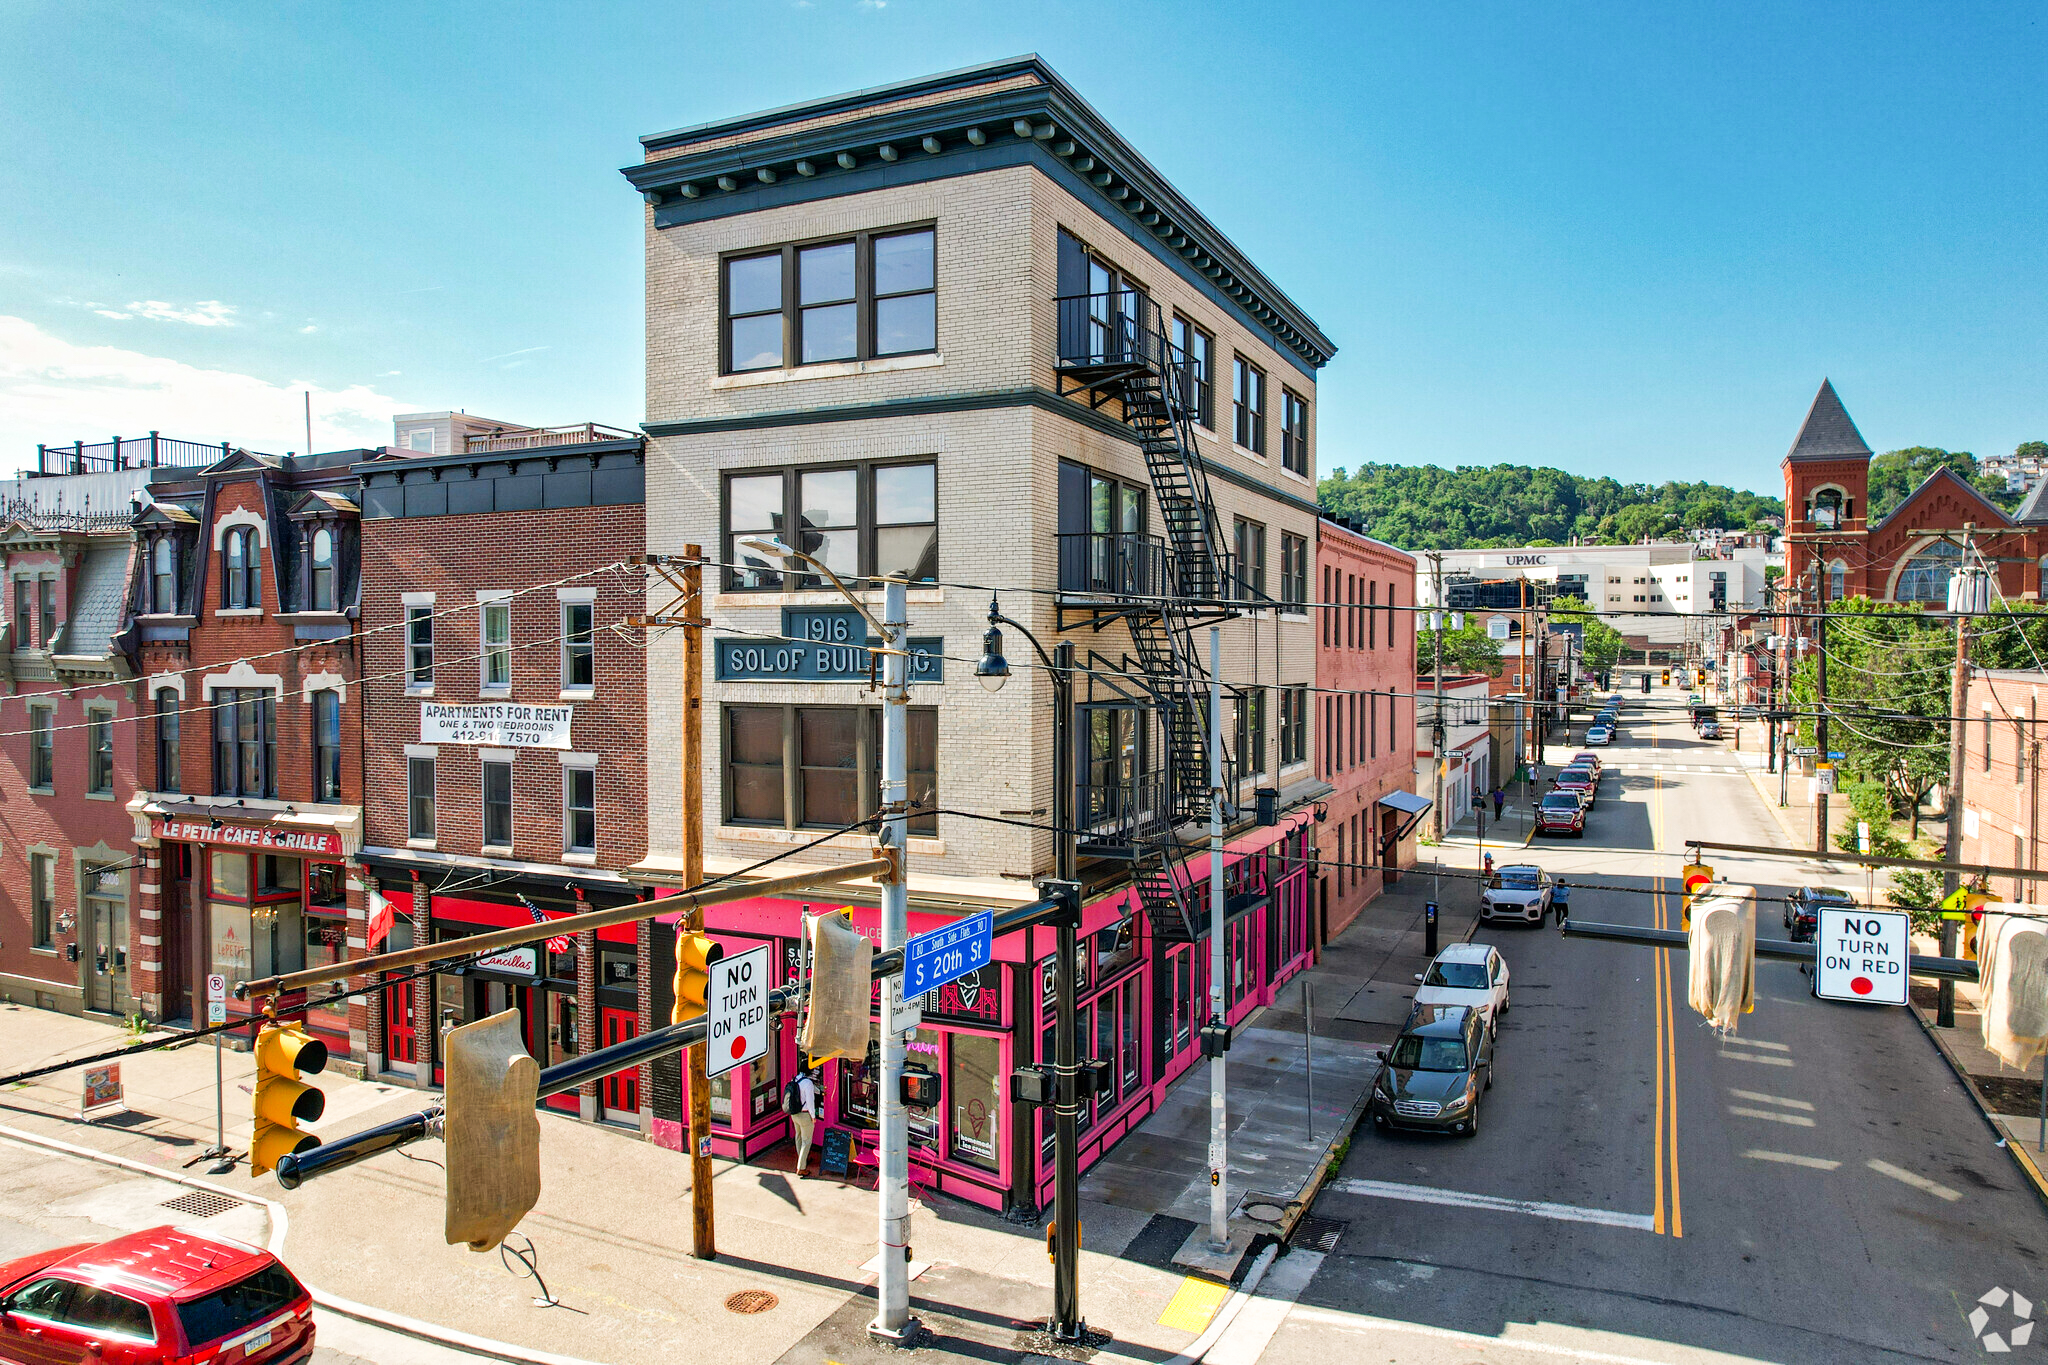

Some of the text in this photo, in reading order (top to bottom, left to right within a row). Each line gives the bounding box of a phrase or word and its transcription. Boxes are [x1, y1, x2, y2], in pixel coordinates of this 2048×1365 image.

[1505, 555, 1546, 565] UPMC
[731, 648, 806, 671] SOLOF
[426, 705, 569, 721] APARTMENTS FOR RENT
[439, 720, 459, 728] ONE
[472, 721, 494, 729] TWO
[496, 721, 554, 731] BEDROOMS
[1820, 777, 1830, 785] 15
[162, 822, 179, 837] LE
[181, 824, 221, 841] PETIT
[224, 828, 260, 845] CAFE
[263, 831, 272, 846] &
[931, 936, 944, 950] South
[947, 932, 957, 943] Side
[960, 926, 970, 938] Flats
[977, 921, 983, 931] 90
[1845, 918, 1881, 936] NO
[1837, 938, 1888, 955] TURN
[916, 939, 982, 985] S 20th St
[1826, 956, 1899, 974] ON RED
[727, 961, 752, 988] NO
[893, 980, 901, 990] NO
[722, 985, 757, 1012] TURN
[713, 1005, 763, 1038] ON RED
[852, 1103, 876, 1115] espresso
[960, 1134, 992, 1149] homemade
[962, 1141, 991, 1155] ice cream
